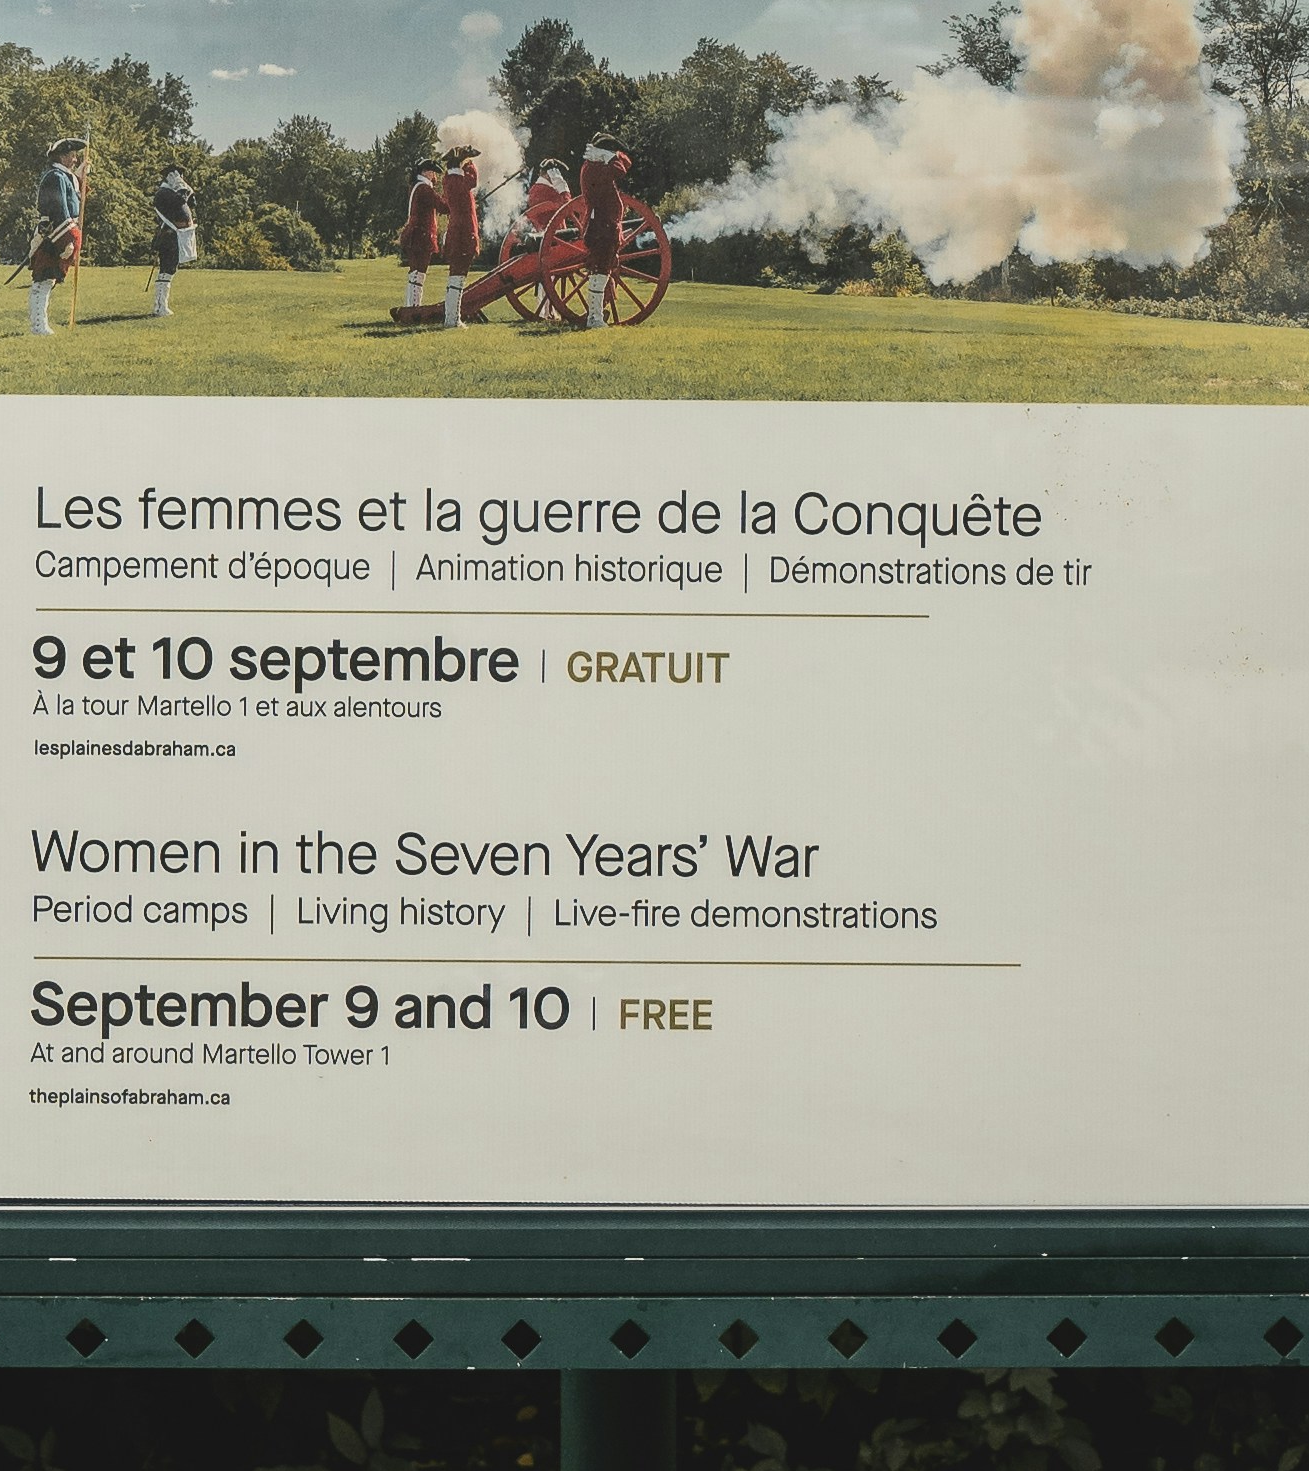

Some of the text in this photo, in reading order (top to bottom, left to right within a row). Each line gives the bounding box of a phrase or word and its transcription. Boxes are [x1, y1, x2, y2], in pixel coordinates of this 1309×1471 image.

[37, 485, 1043, 548] Les femmes et la guerre de la Conquête
[35, 549, 1093, 592] Campement d’époque Animation historique Démonstrations de tir
[32, 634, 731, 695] 9 et 10 septembre GRATUIT
[32, 688, 442, 719] À la tour Martello 1 et aux alentours
[34, 738, 236, 760] lesplainesdabraham.ca
[30, 829, 820, 879] Women in the Seven Years’ War
[33, 893, 938, 935] Period camps Living history Live-fire demonstrations
[30, 980, 713, 1040] September 9 and 10 FREE
[29, 1041, 389, 1067] At and around Martello Tower 1
[28, 1087, 231, 1109] theplainsofabraham.ca
